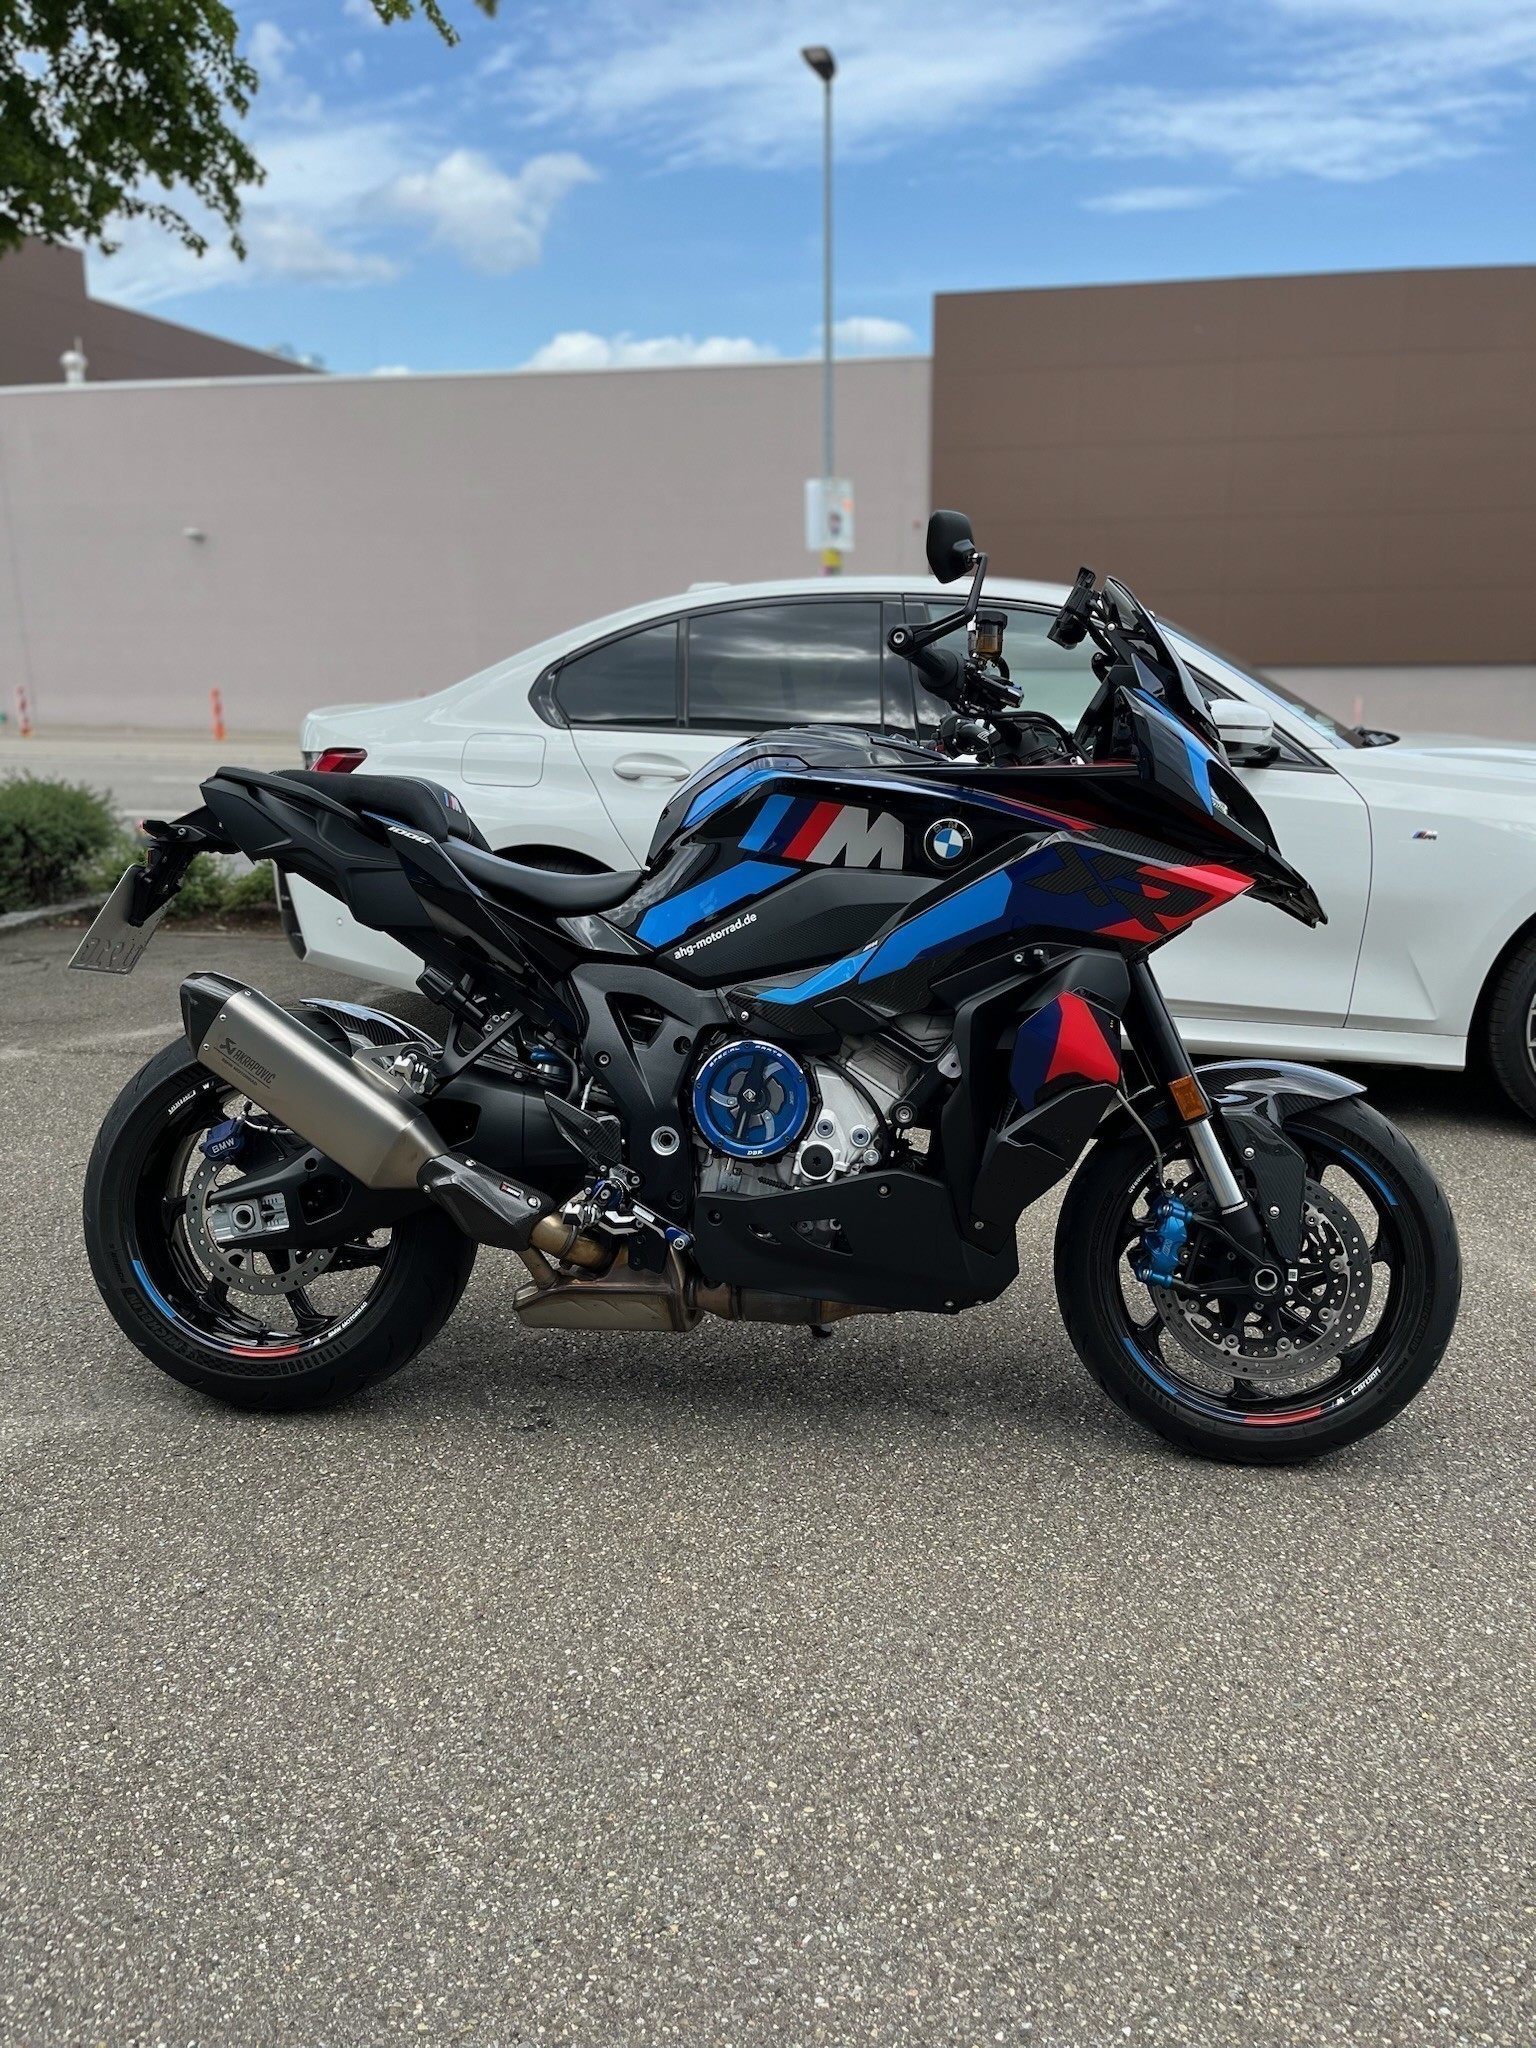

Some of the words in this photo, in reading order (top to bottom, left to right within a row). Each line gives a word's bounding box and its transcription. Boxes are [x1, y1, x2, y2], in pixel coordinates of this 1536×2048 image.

[805, 805, 905, 870] M
[673, 913, 757, 960] ahg-motorrad.de
[211, 1138, 236, 1154] BMW
